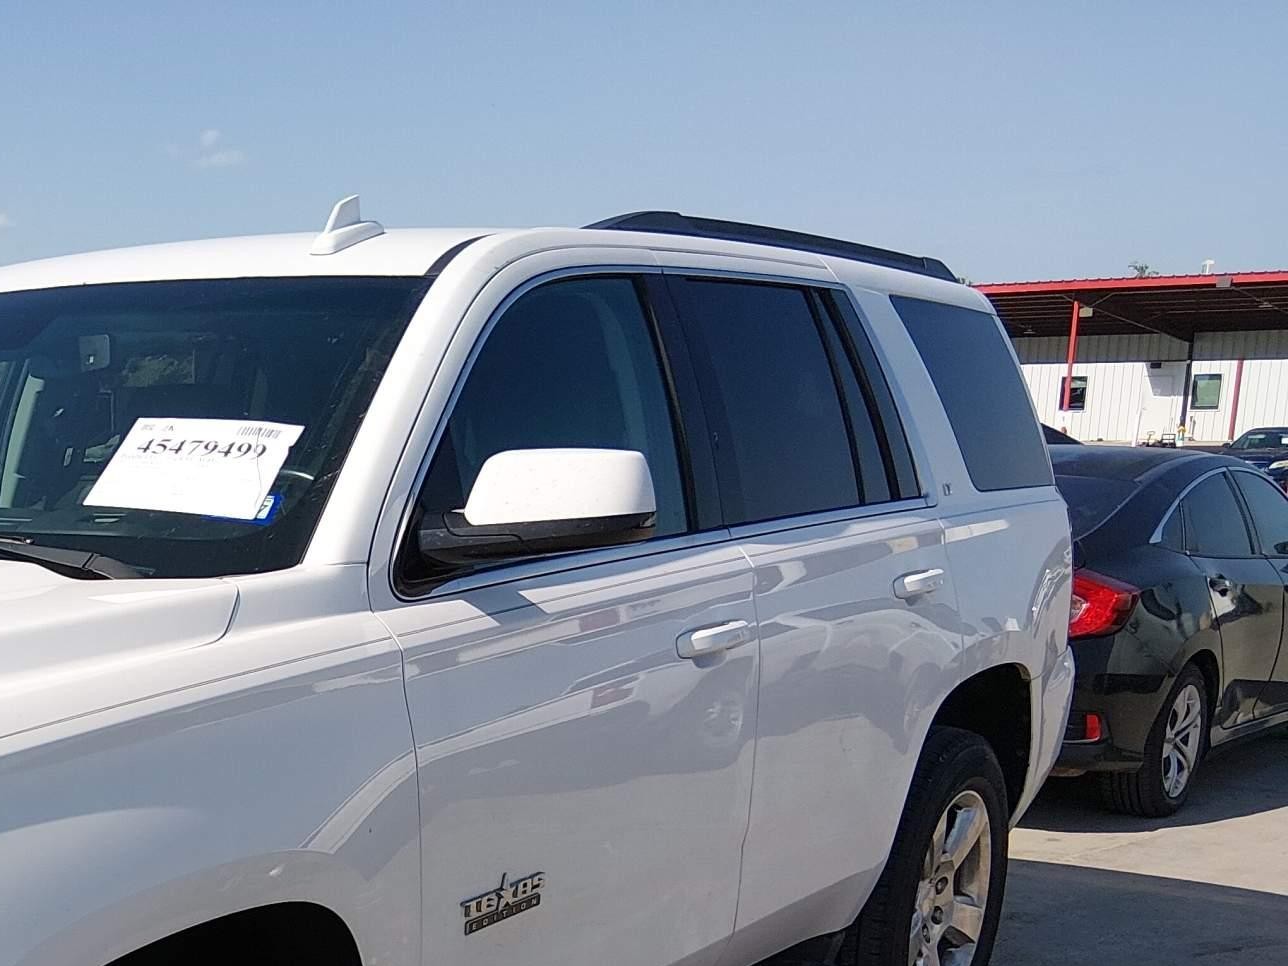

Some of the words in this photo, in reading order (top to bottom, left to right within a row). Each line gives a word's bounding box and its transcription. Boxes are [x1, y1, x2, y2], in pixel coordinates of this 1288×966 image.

[136, 437, 268, 460] 45479499
[460, 872, 545, 918] TEXAS
[470, 897, 539, 930] EDITION
